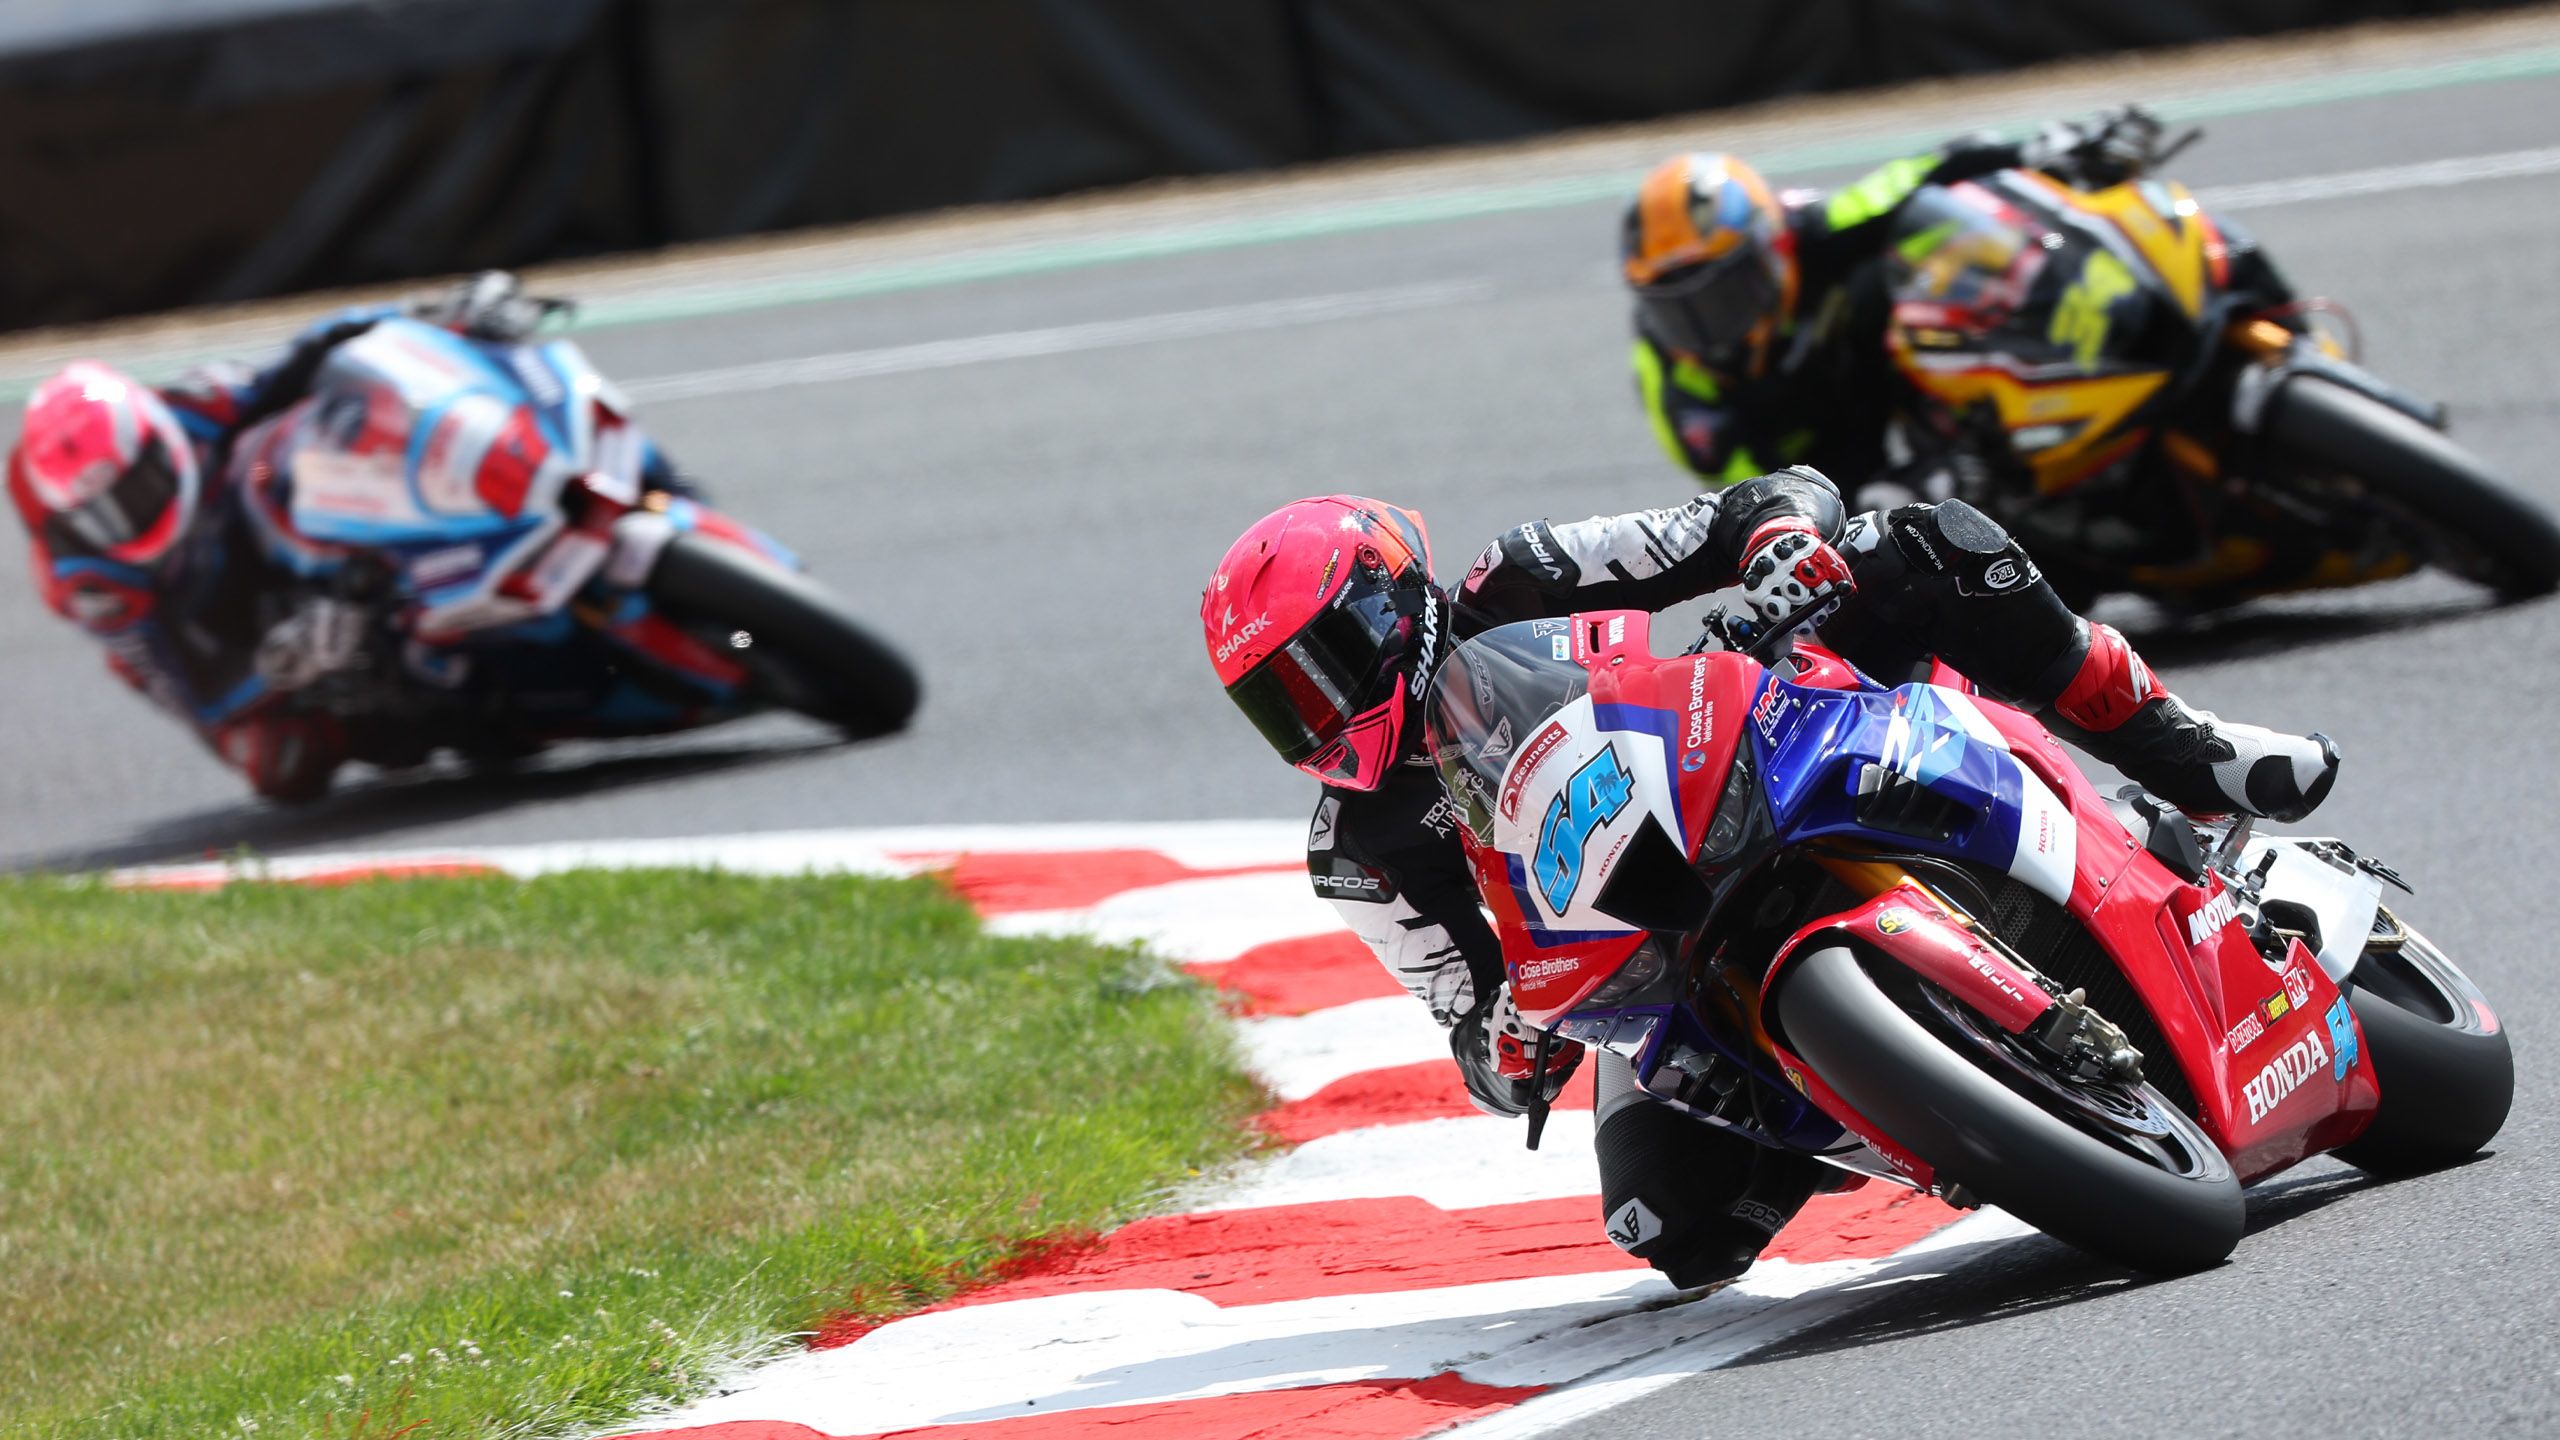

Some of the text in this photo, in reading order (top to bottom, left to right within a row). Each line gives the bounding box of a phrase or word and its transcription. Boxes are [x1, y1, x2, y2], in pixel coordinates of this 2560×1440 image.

[1521, 521, 1563, 580] VIRCO
[1990, 563, 2015, 584] R&G
[1333, 578, 1354, 610] SHARK
[1216, 611, 1274, 663] SHARK
[1411, 585, 1438, 701] SHARK
[1687, 656, 1707, 749] Close Brothers
[1703, 700, 1714, 744] Vehicle Hire
[1753, 675, 1788, 735] HRC
[1513, 728, 1562, 786] Bennetts
[1420, 796, 1451, 829] TECH
[1532, 740, 1636, 918] 54
[1310, 874, 1380, 890] IRCOS
[1599, 834, 1628, 878] HONDA
[2188, 889, 2237, 946] MOTUL
[1519, 957, 1579, 980] Close Brothers
[2286, 969, 2305, 999] RK
[2227, 1011, 2264, 1054] DATATOOL
[2325, 994, 2358, 1082] 54
[2242, 1030, 2329, 1126] HONDA
